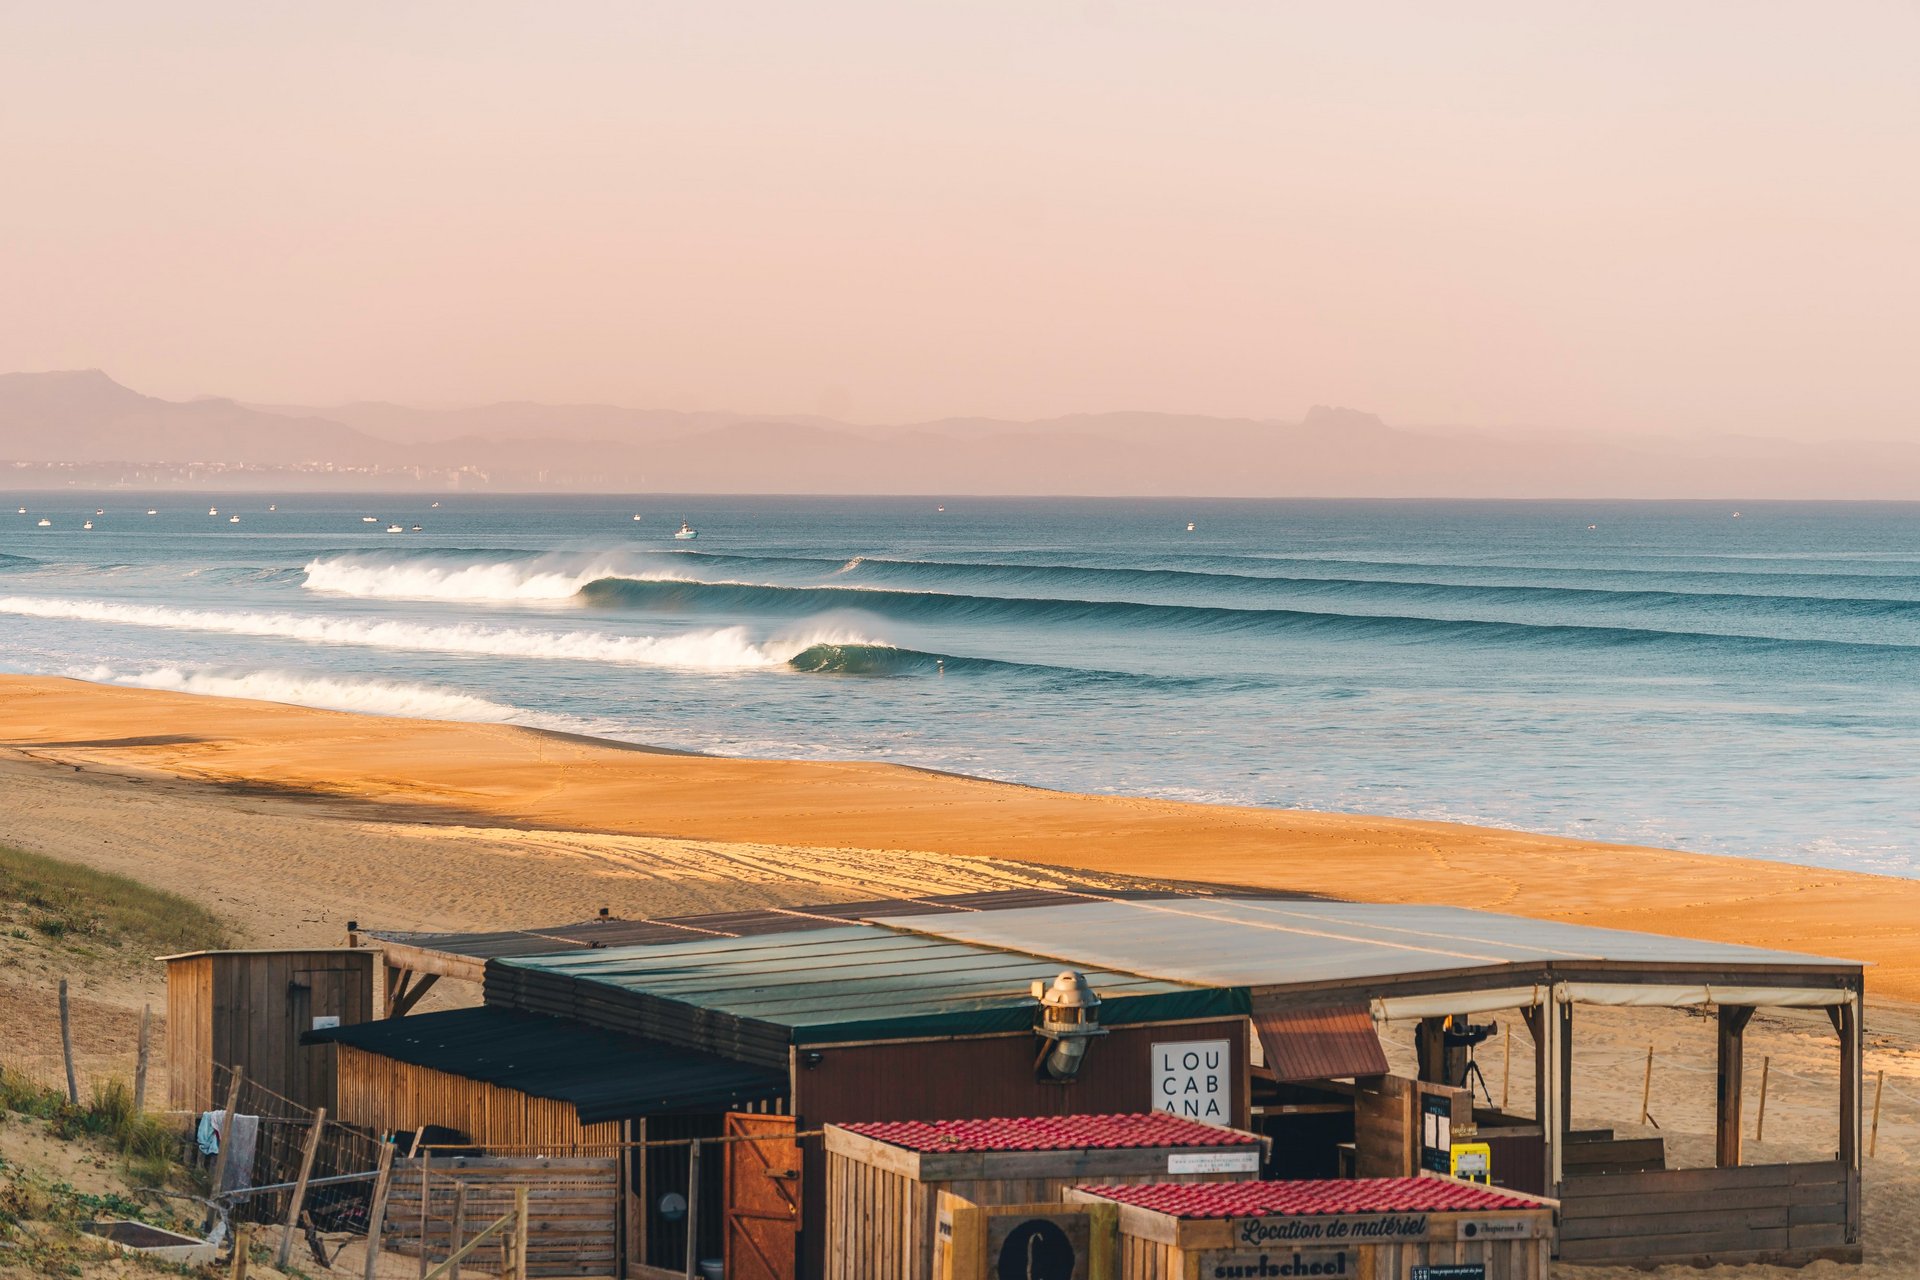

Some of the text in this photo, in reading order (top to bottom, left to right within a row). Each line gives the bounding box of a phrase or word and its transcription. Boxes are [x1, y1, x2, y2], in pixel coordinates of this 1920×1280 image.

[1164, 1051, 1219, 1071] LOU
[1162, 1075, 1218, 1095] CAB
[1165, 1098, 1220, 1117] ANA
[1241, 1215, 1426, 1246] Location de matériel
[1215, 1252, 1346, 1278] surfschool
